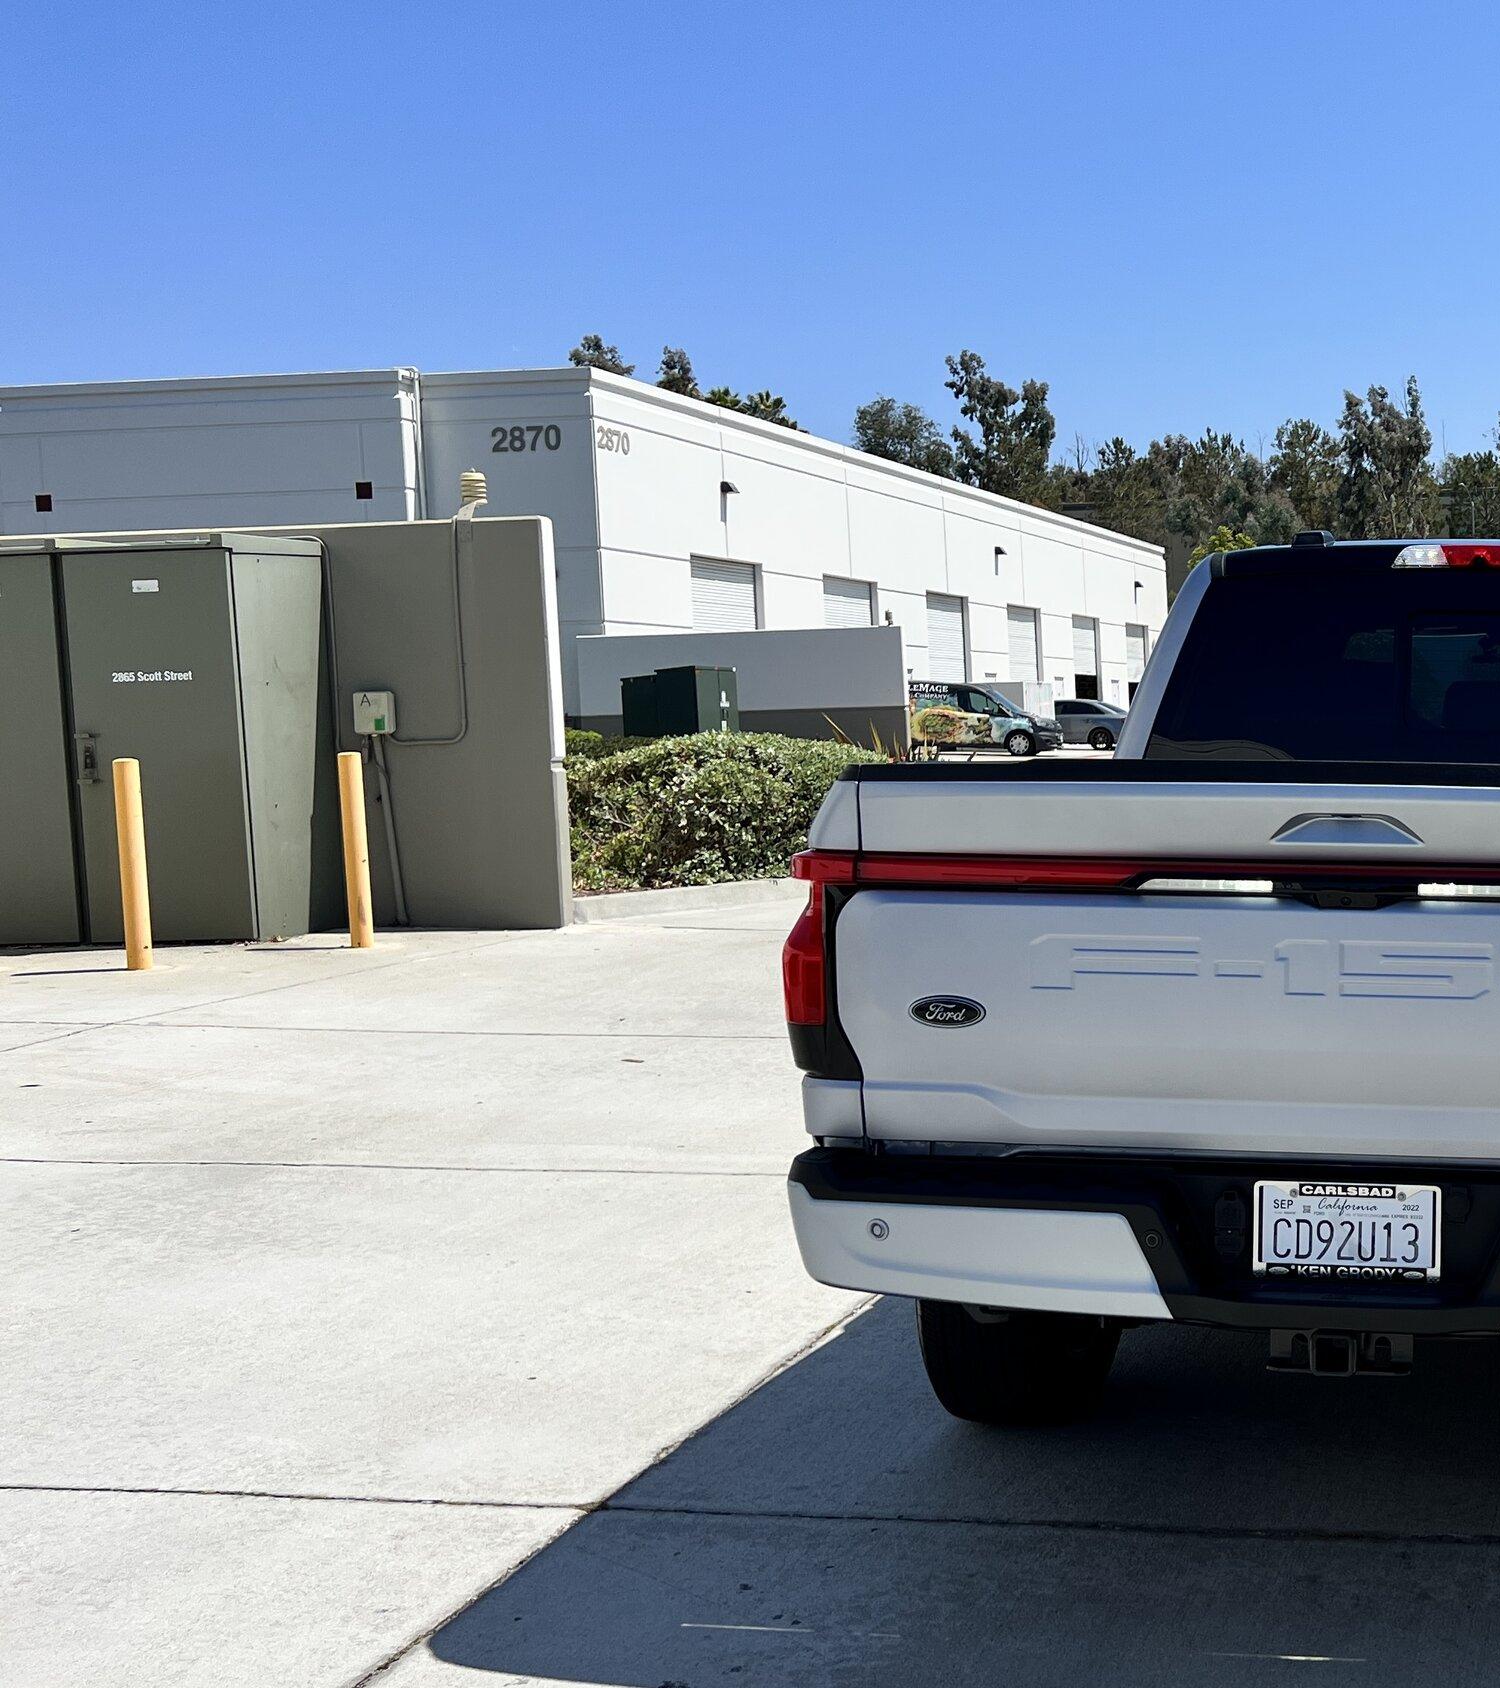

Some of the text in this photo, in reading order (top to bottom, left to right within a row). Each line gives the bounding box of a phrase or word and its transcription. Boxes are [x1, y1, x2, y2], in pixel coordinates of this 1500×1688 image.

[491, 424, 562, 453] 2870
[597, 425, 631, 456] 2870
[111, 670, 193, 683] 2865 Scott Street
[360, 693, 371, 707] A
[925, 1002, 966, 1021] Ford
[1301, 1185, 1394, 1197] CARLSBAD
[1273, 1198, 1294, 1210] SEP
[1317, 1197, 1379, 1217] California
[1402, 1204, 1420, 1212] 2022
[1272, 1217, 1421, 1264] CD92U13
[1297, 1265, 1331, 1278] KEN
[1336, 1266, 1397, 1281] GRODY
